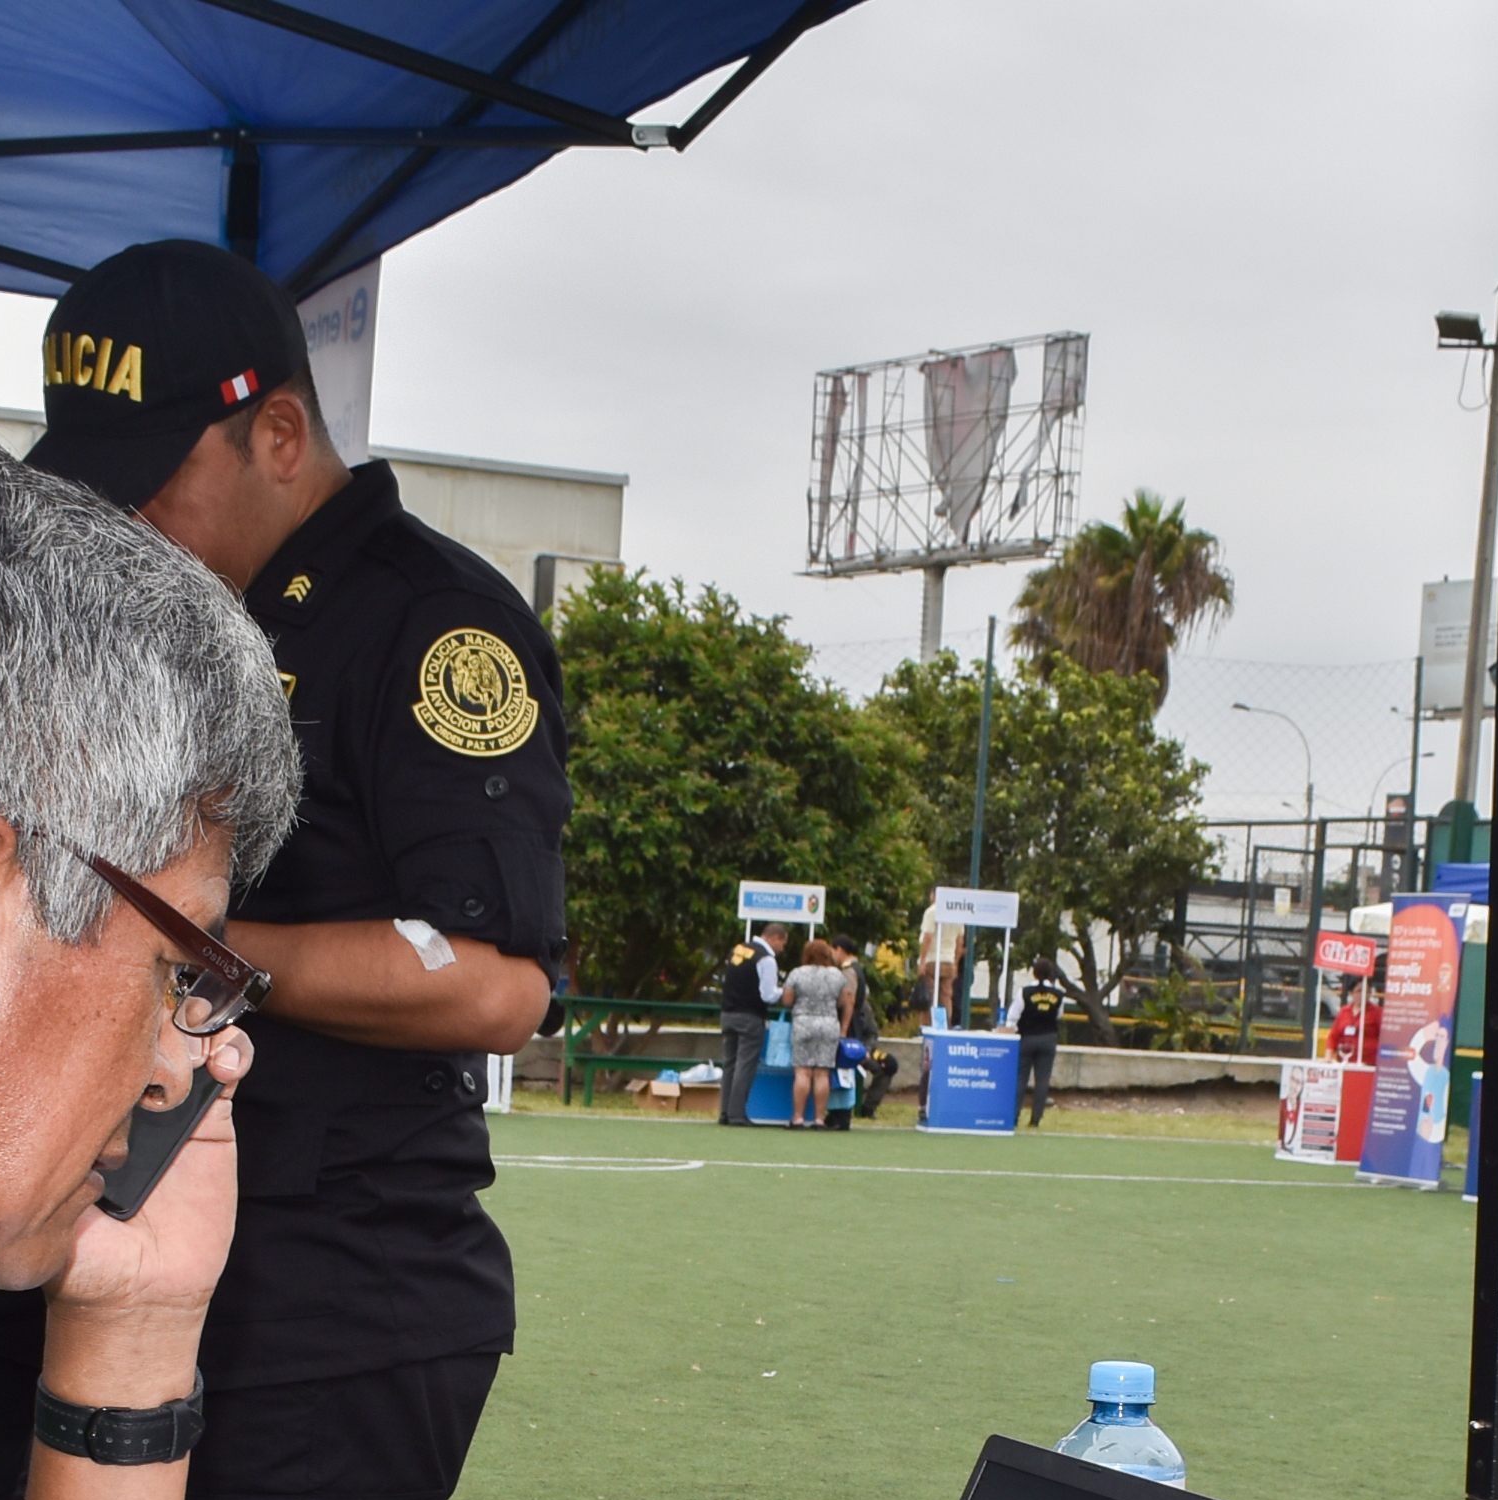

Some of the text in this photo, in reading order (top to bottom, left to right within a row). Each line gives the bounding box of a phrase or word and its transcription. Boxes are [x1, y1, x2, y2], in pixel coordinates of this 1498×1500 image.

[44, 332, 142, 402] LICIA
[426, 633, 521, 683] POLICIA NACIONAL
[428, 688, 523, 733] AVIACION POLICIAL
